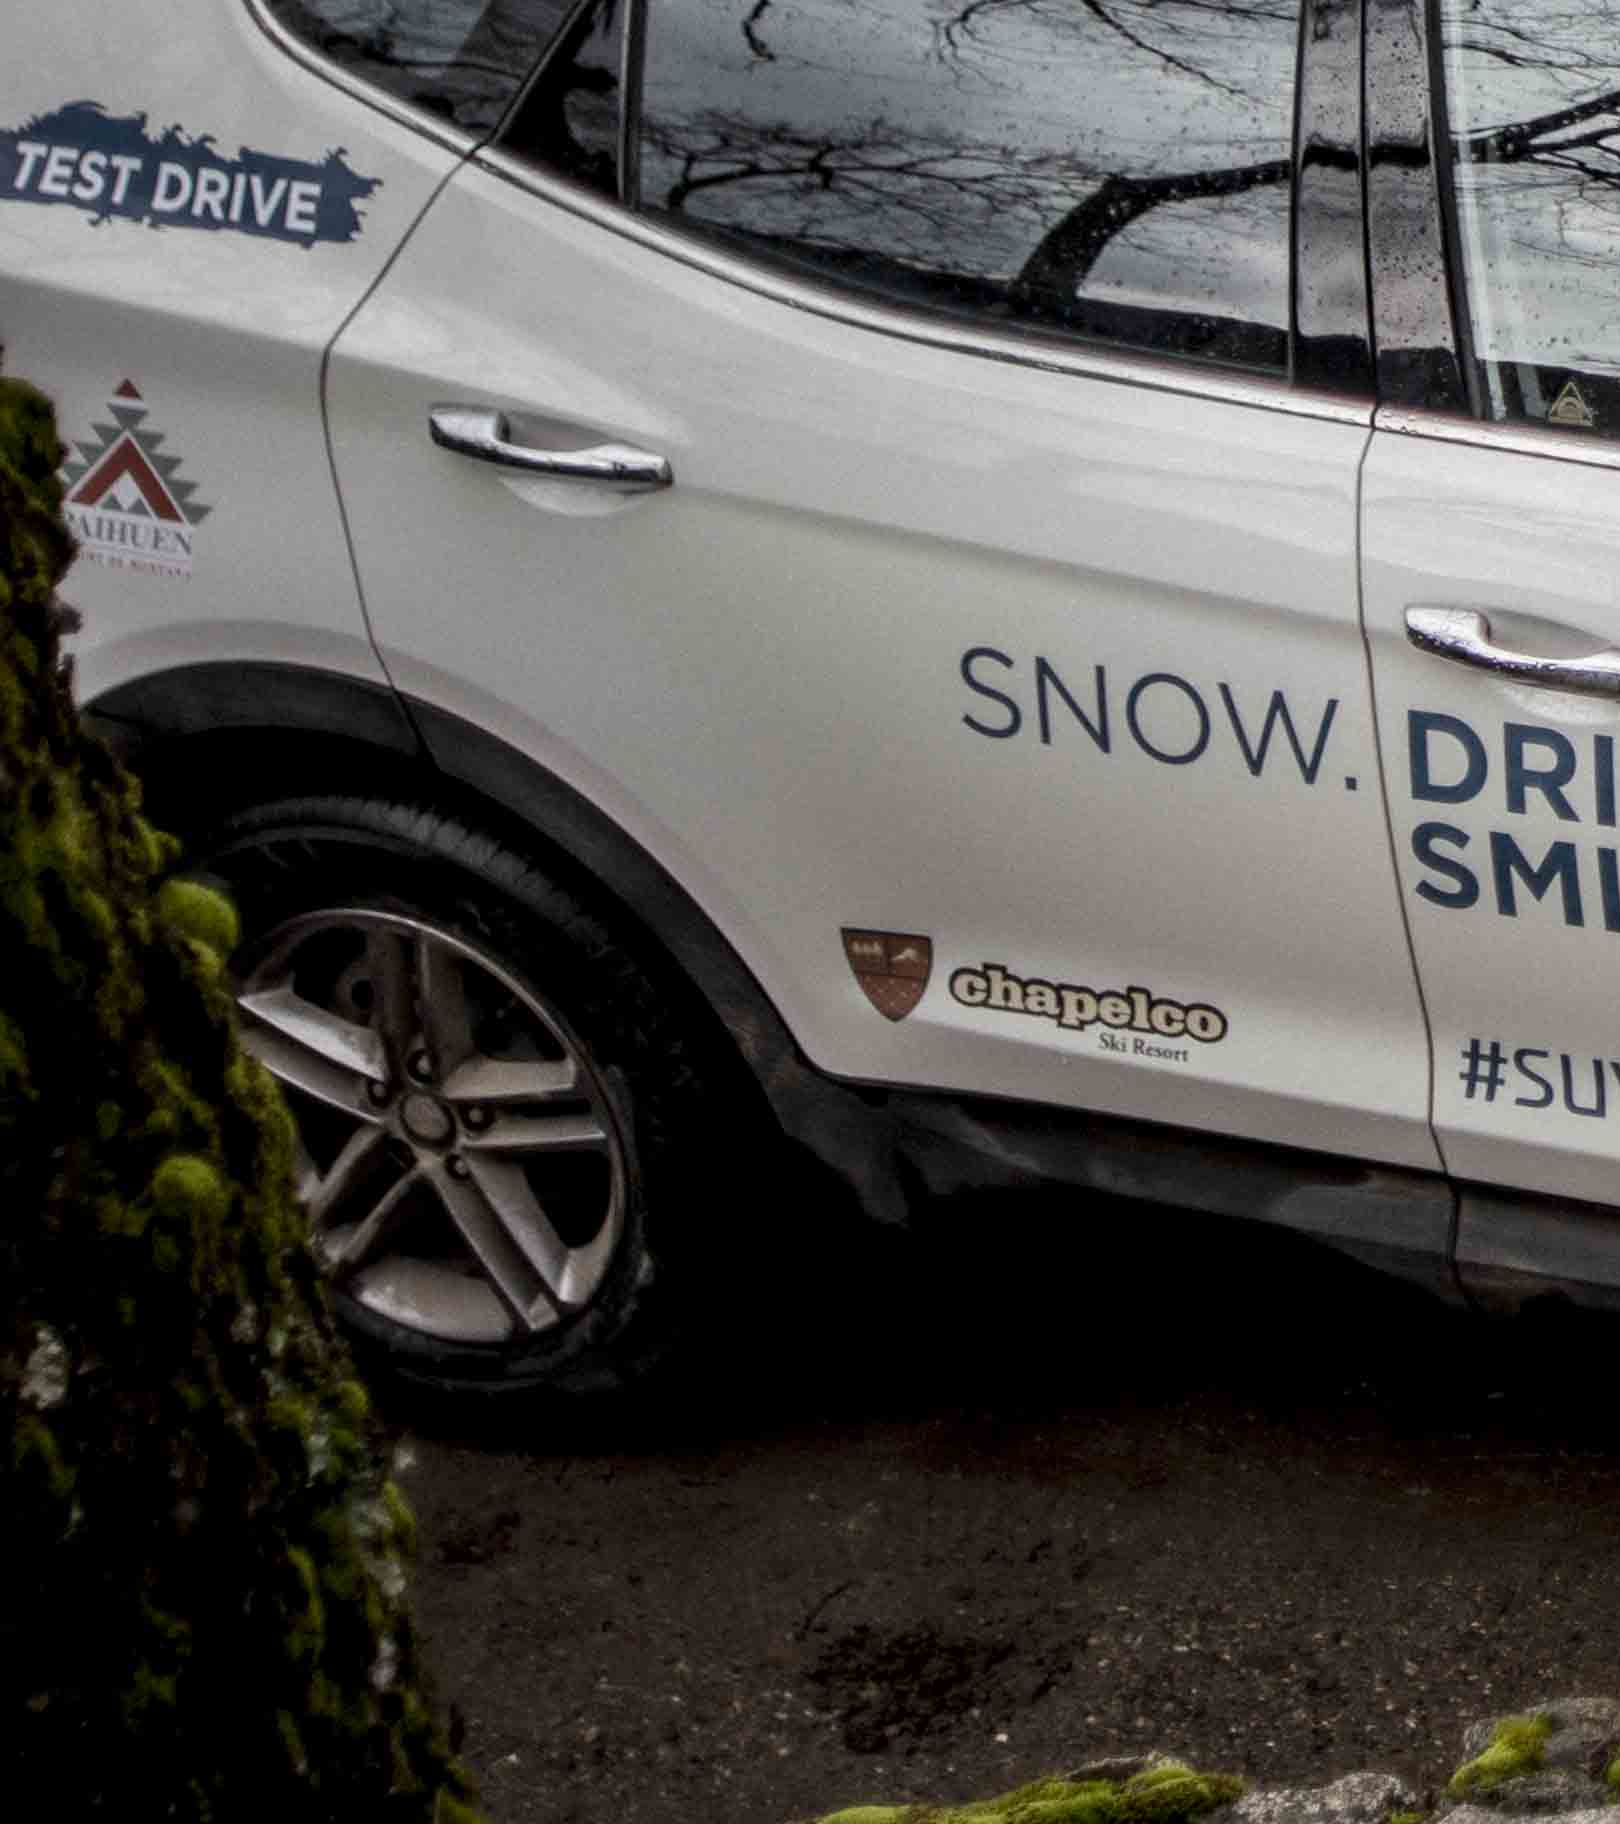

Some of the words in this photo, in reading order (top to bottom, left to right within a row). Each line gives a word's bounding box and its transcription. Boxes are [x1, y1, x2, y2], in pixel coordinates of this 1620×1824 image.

[14, 142, 141, 204] TEST
[152, 163, 321, 232] DRIVE
[960, 648, 1357, 790] SNOW.
[949, 962, 1229, 1042] chapelco
[1099, 1032, 1128, 1054] Ski
[1132, 1039, 1190, 1064] Resort
